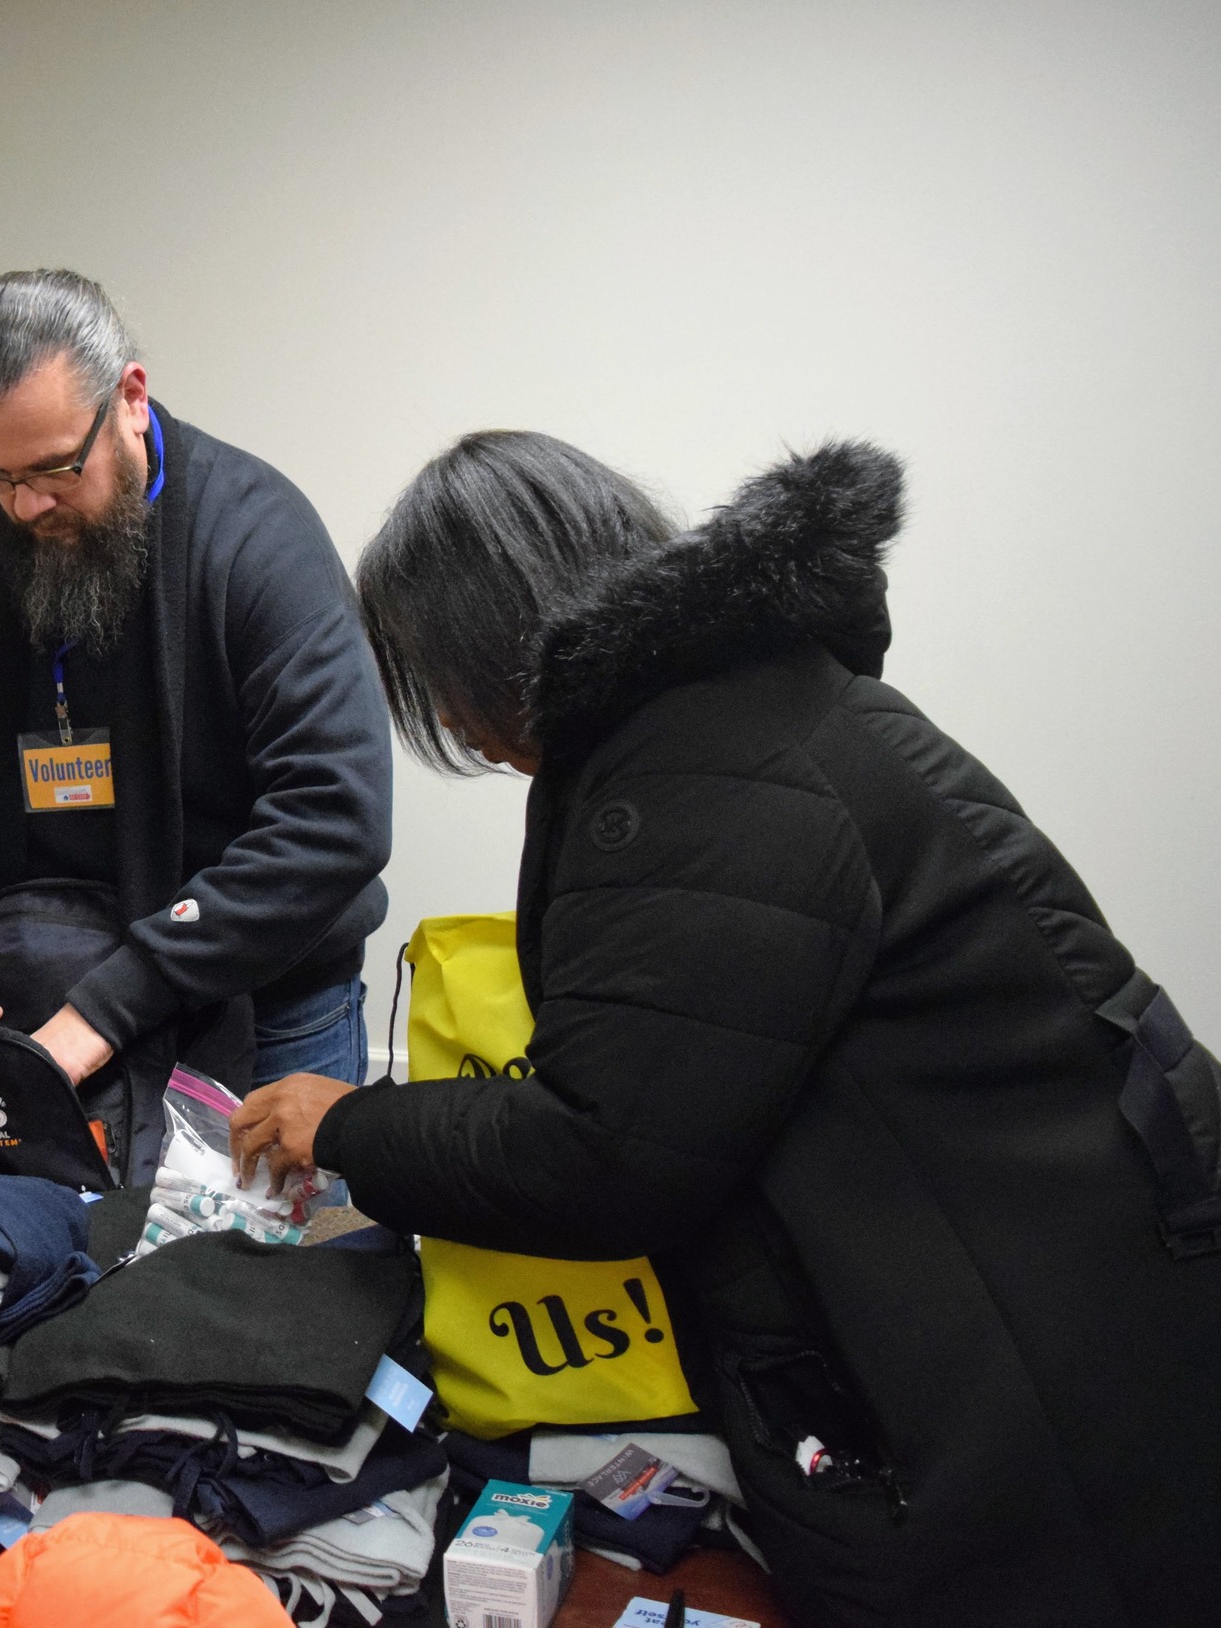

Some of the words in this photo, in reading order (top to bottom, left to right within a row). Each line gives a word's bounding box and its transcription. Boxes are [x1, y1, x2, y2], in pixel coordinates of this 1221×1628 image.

[28, 757, 111, 783] Volunteer
[489, 1278, 664, 1377] Us!
[586, 1449, 635, 1488] WINTERLACE
[493, 1493, 548, 1509] moxie
